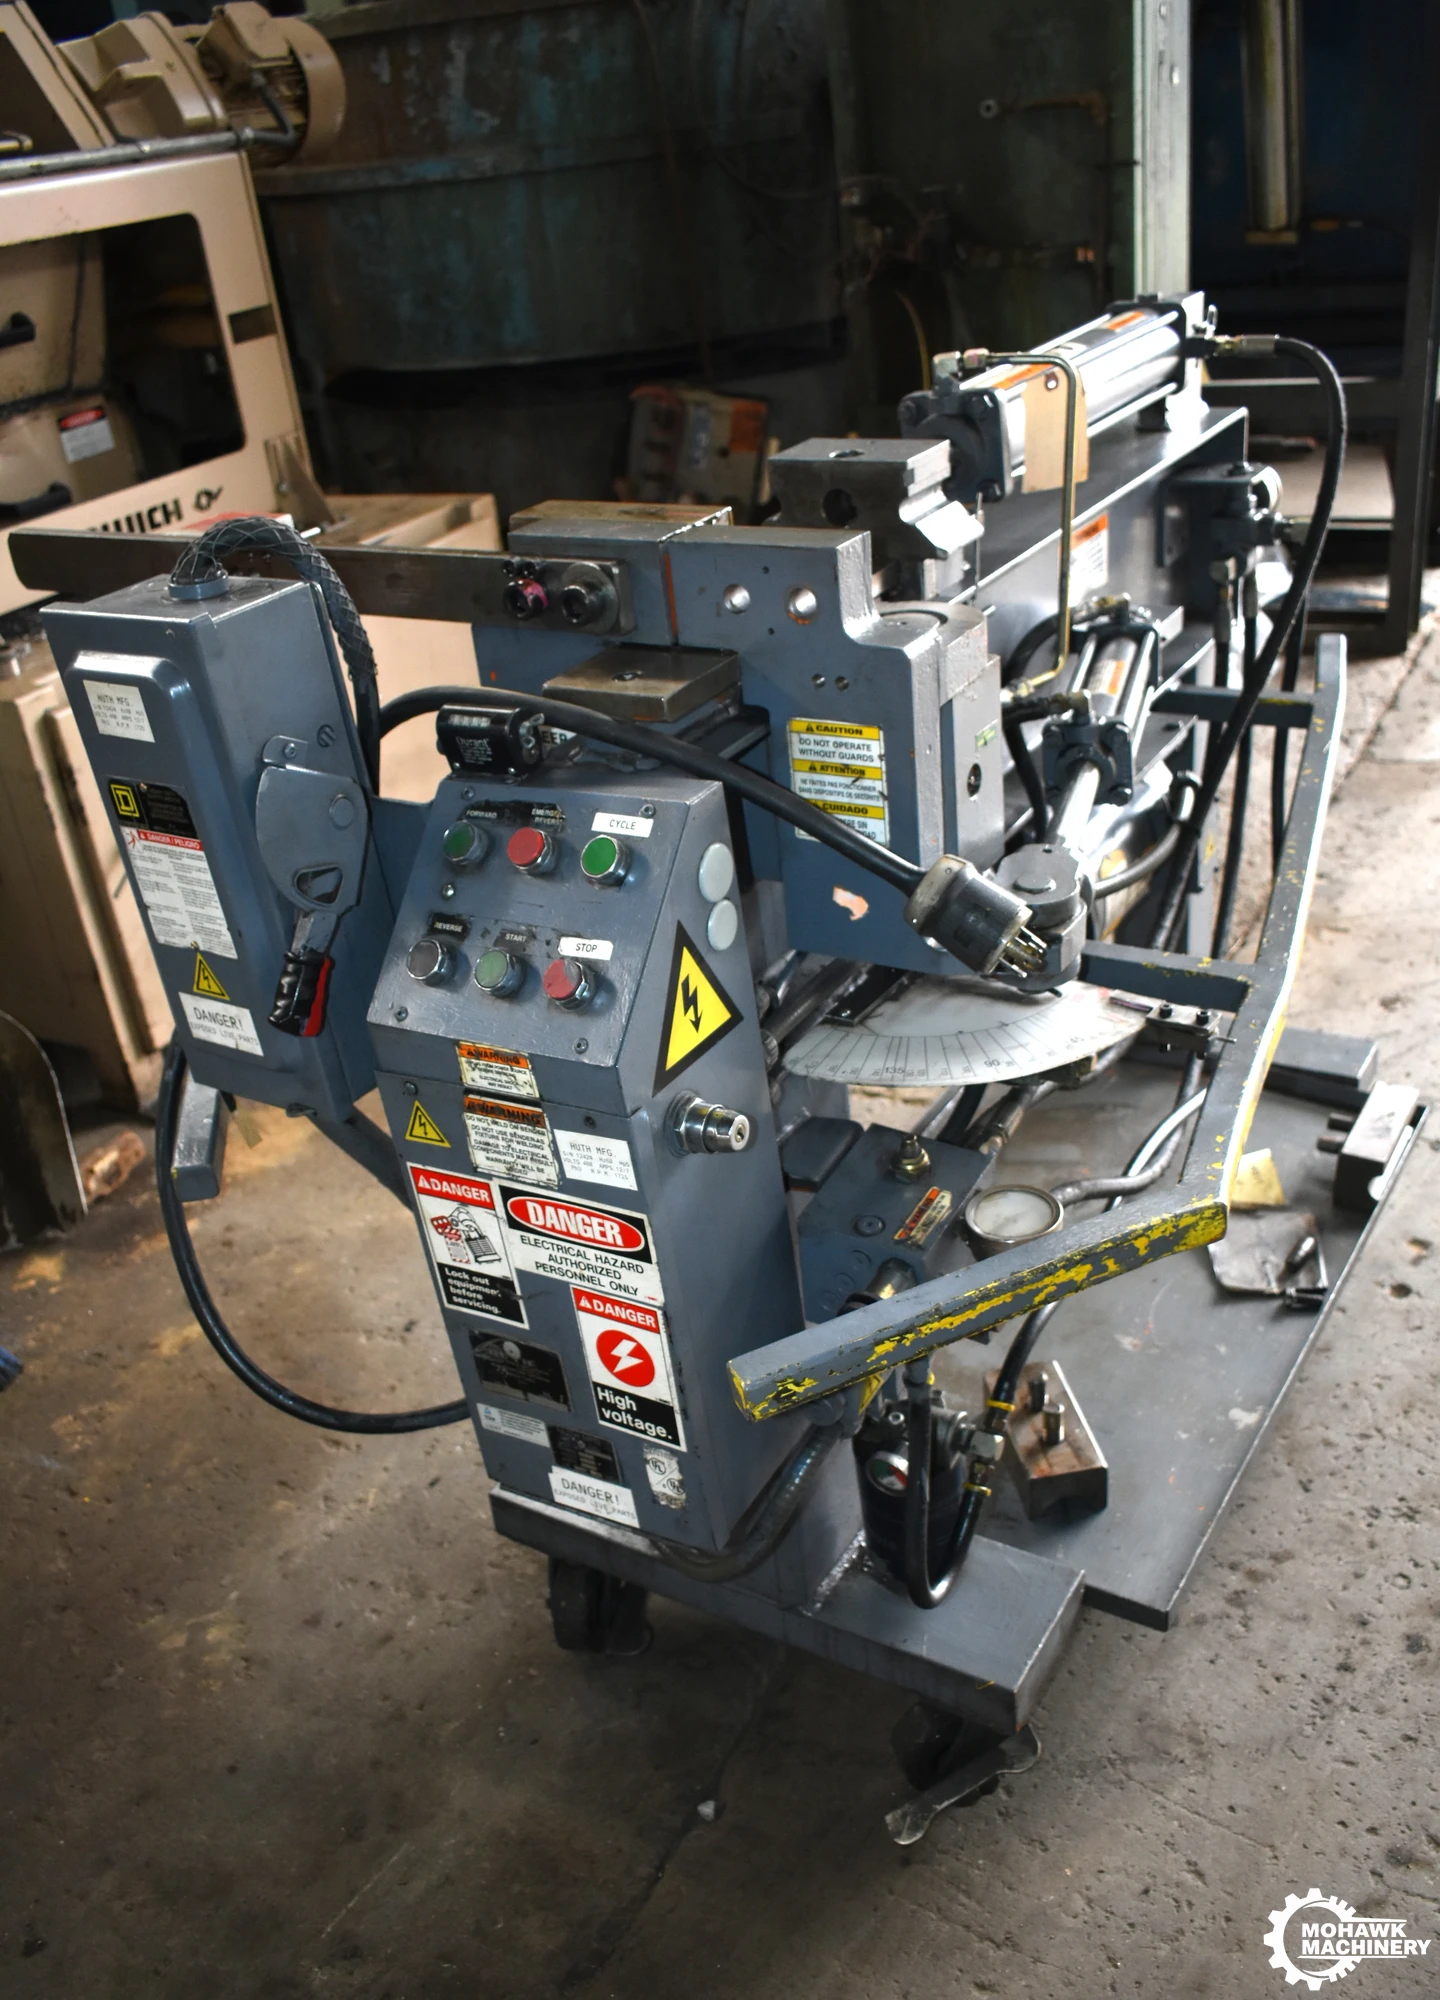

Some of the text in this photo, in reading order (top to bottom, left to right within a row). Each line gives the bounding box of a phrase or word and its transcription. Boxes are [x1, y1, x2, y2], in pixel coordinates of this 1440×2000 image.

[815, 724, 863, 735] CAUTION
[799, 737, 872, 752] DO NOT OPERATE
[798, 747, 874, 762] WITHOUT GUARDS
[819, 764, 866, 776] ATTENTION
[798, 786, 812, 794] SANS
[838, 782, 877, 793] FONCTIONNER
[466, 809, 498, 819] FORWARD
[822, 802, 868, 815] CUIDADO
[609, 818, 637, 831] CYCLE
[857, 820, 868, 829] SIN
[146, 832, 171, 844] DANGER
[174, 837, 200, 850] PELIGRO
[434, 921, 463, 932] REVERSE
[505, 932, 528, 942] START
[575, 942, 598, 953] STOP
[193, 1007, 244, 1032] DANGER!
[238, 1034, 259, 1046] PARTS
[475, 1049, 520, 1065] WARNING
[983, 1058, 1000, 1068] 90
[885, 1066, 905, 1074] 135
[479, 1074, 503, 1083] ELECTRICAL
[476, 1116, 490, 1124] NOT
[491, 1119, 508, 1128] WELD
[509, 1122, 519, 1130] ON
[520, 1125, 546, 1136] BENDER
[474, 1131, 500, 1141] FIXTURE
[515, 1140, 545, 1150] WELDING
[496, 1128, 508, 1136] USE
[509, 1132, 535, 1143] BENDER
[535, 1137, 545, 1145] AS
[474, 1139, 500, 1149] DAMAGE
[511, 1147, 549, 1160] ELECTRICAL
[569, 1142, 592, 1153] HUTH
[472, 1145, 515, 1158] COMPONENTS
[529, 1156, 554, 1167] RESULT
[485, 1156, 545, 1174] WARRANTY WILL BE
[430, 1178, 491, 1203] DANGER
[526, 1201, 624, 1247] DANGER
[520, 1235, 645, 1274] ELECTRICAL HAZARD
[548, 1254, 622, 1280] AUTHORIZED
[444, 1267, 470, 1280] Lock
[472, 1275, 490, 1285] out
[535, 1261, 639, 1296] PERSONNEL ONLY
[450, 1286, 483, 1300] before
[452, 1296, 502, 1314] servicing.
[592, 1299, 656, 1329] DANGER
[596, 1386, 637, 1411] High
[602, 1407, 673, 1440] voltage.
[553, 1488, 586, 1505] EXPOSED
[561, 1477, 619, 1506] DANGER!
